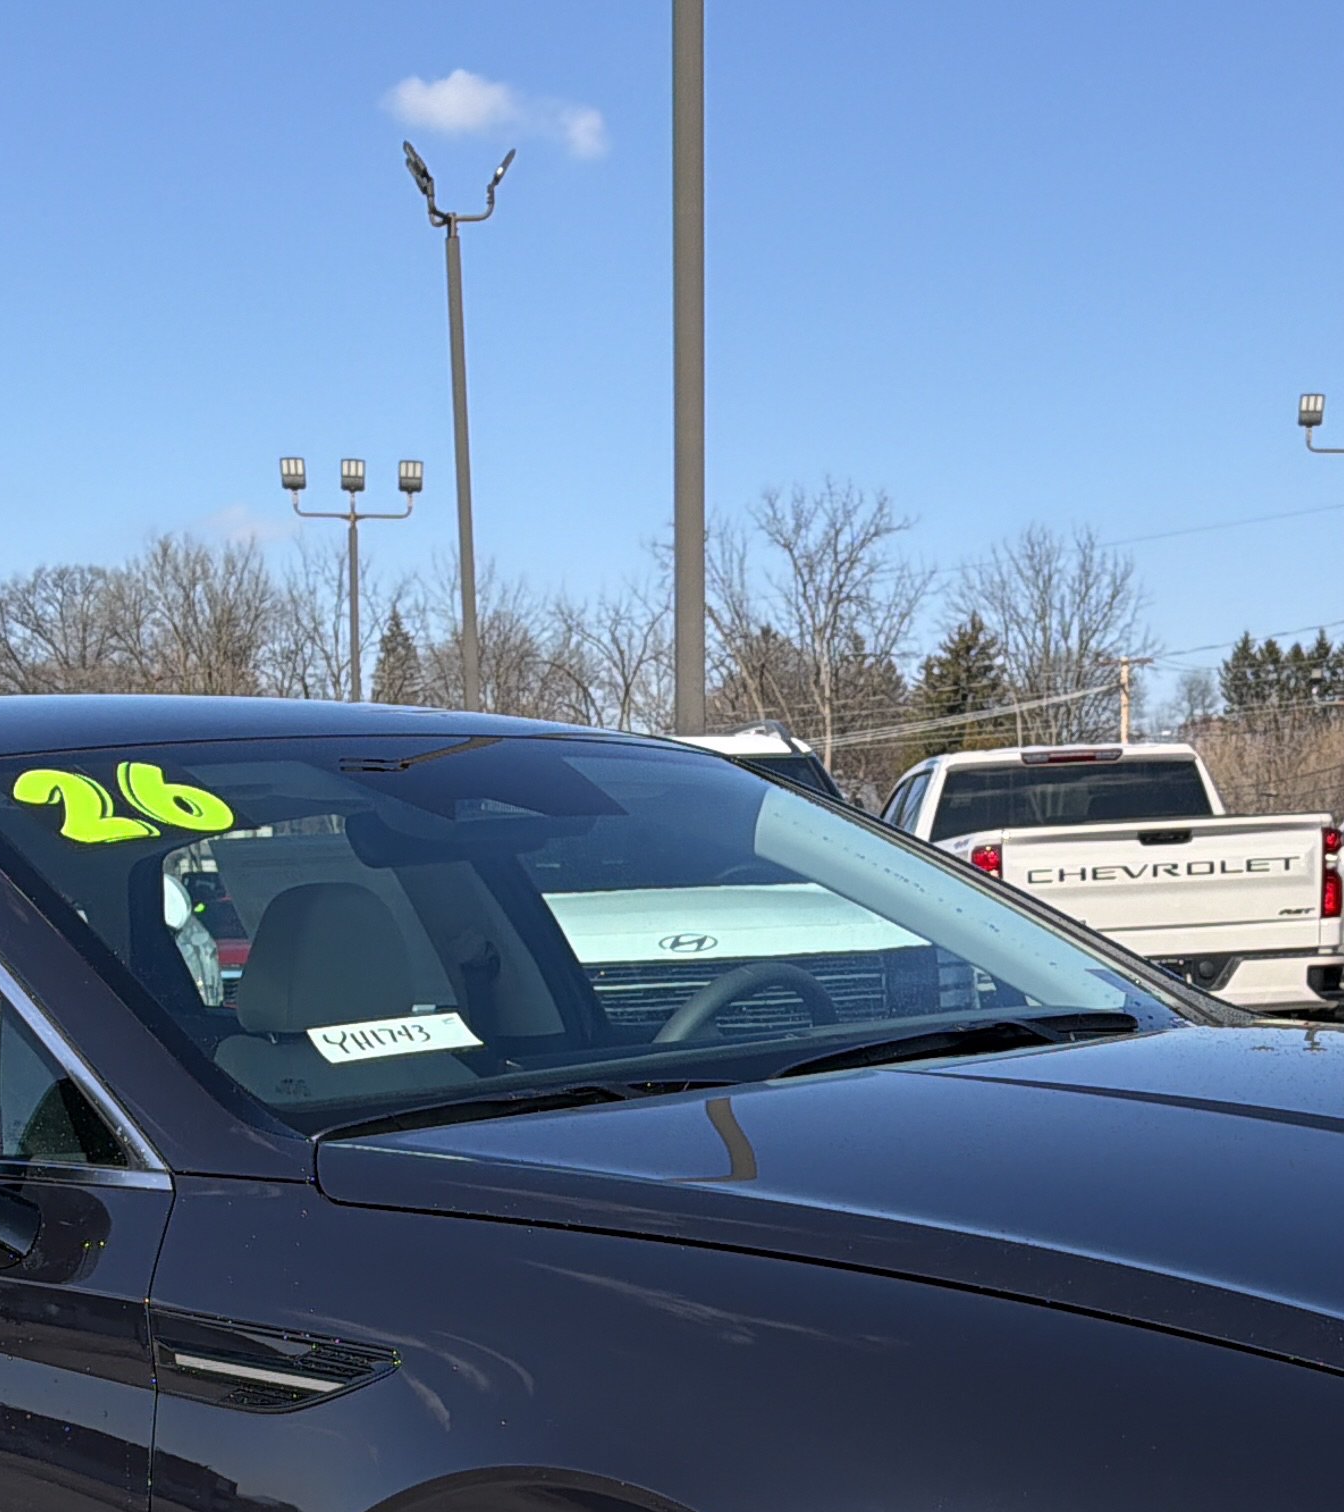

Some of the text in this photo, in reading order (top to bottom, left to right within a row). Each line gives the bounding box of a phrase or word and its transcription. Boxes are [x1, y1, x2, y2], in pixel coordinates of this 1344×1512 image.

[14, 761, 234, 843] 26
[1027, 855, 1301, 884] CHEVROLET
[322, 1014, 431, 1054] YH1743
